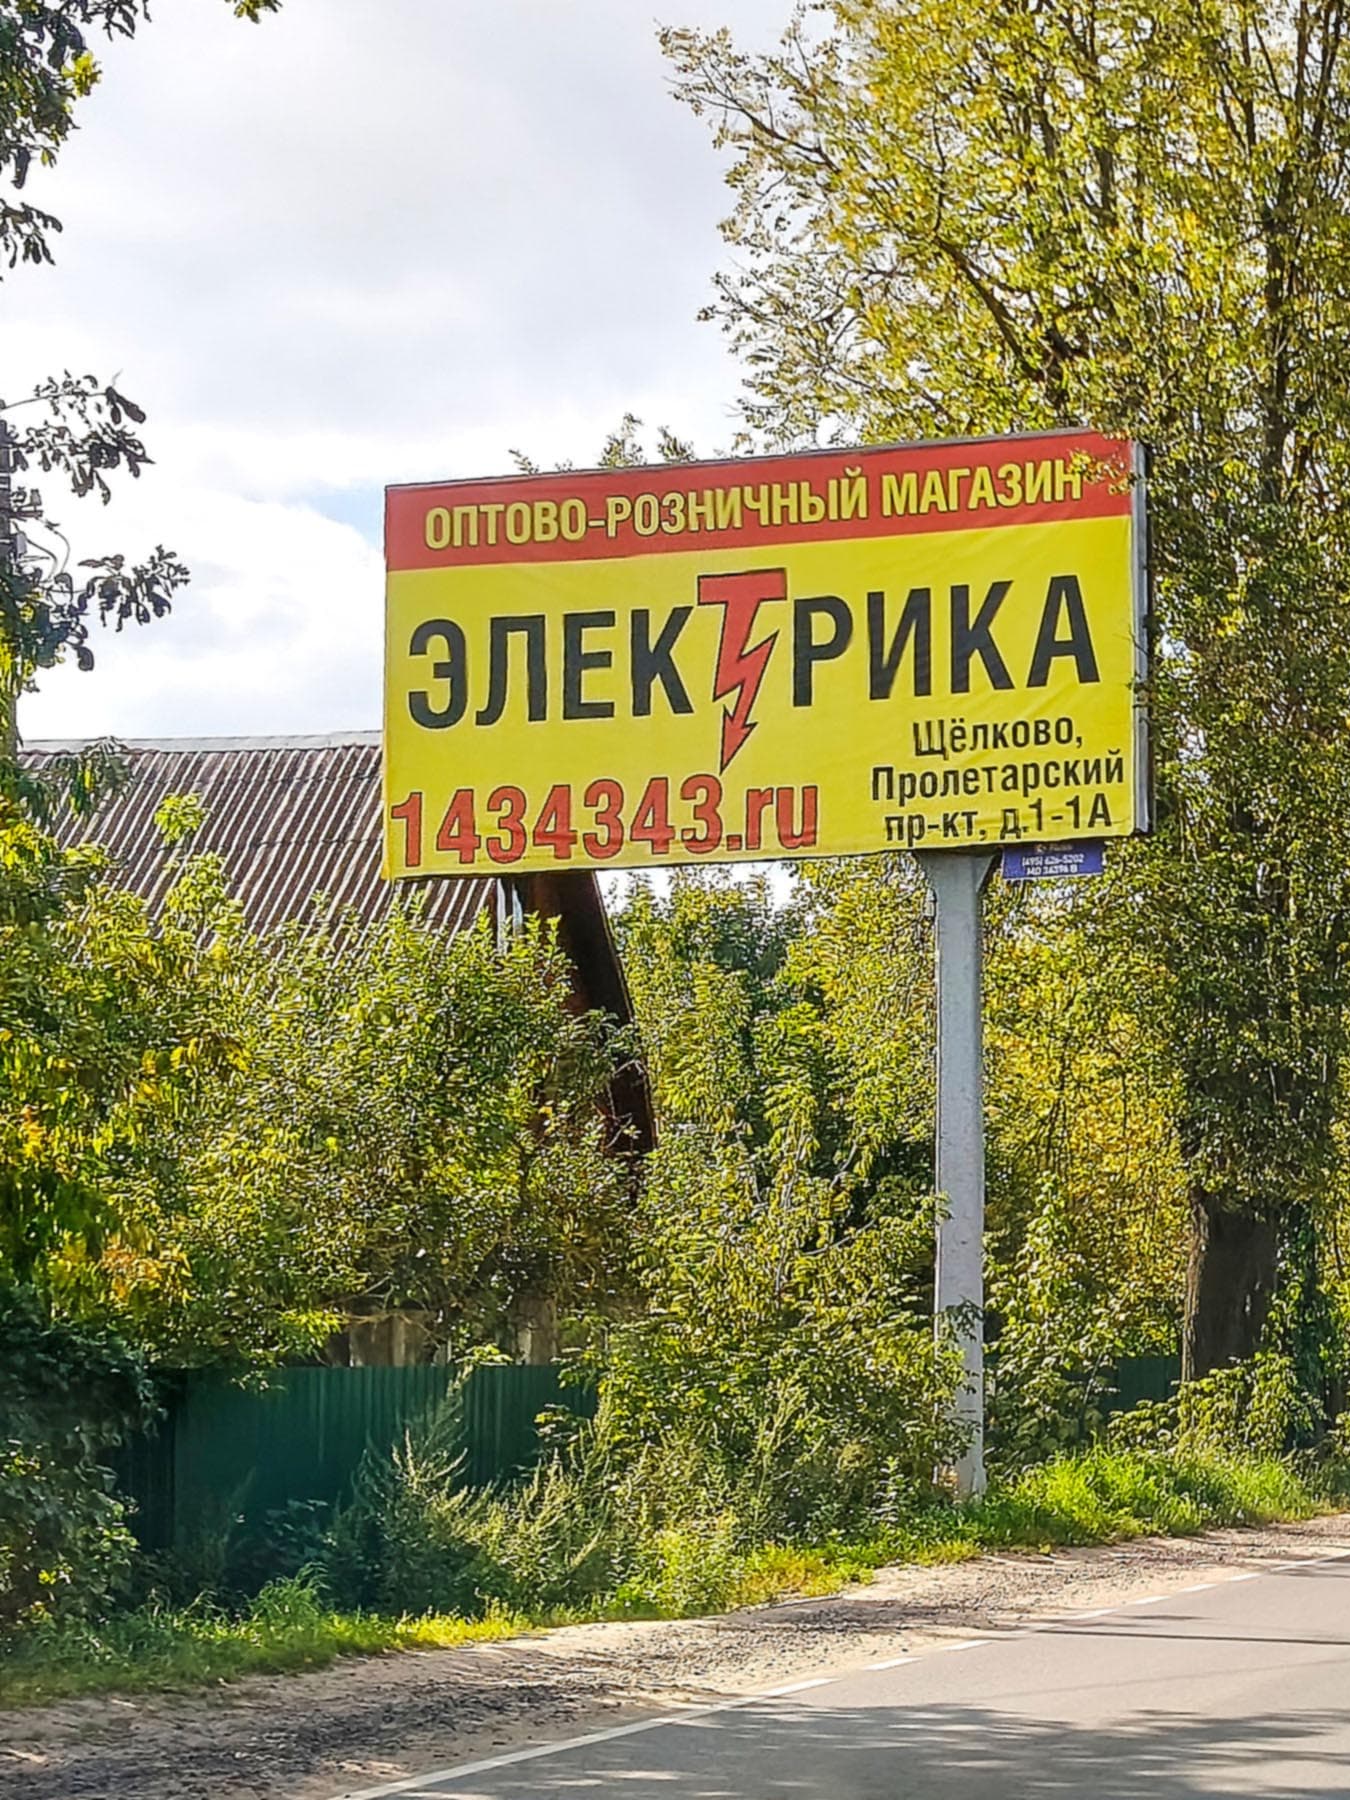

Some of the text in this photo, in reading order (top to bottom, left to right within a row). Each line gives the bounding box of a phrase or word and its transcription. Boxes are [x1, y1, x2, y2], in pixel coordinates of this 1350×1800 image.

[425, 458, 1082, 550] ОПТОВО-РОЗНИЧНЫЙ МАГАЗИН
[408, 568, 1101, 773] ЭЛЕКТРИКА
[912, 717, 1083, 760] Щёлково,
[872, 748, 1124, 807] Пролетарский
[391, 774, 818, 867] 1434343.ru
[885, 810, 988, 847] пр-кт,
